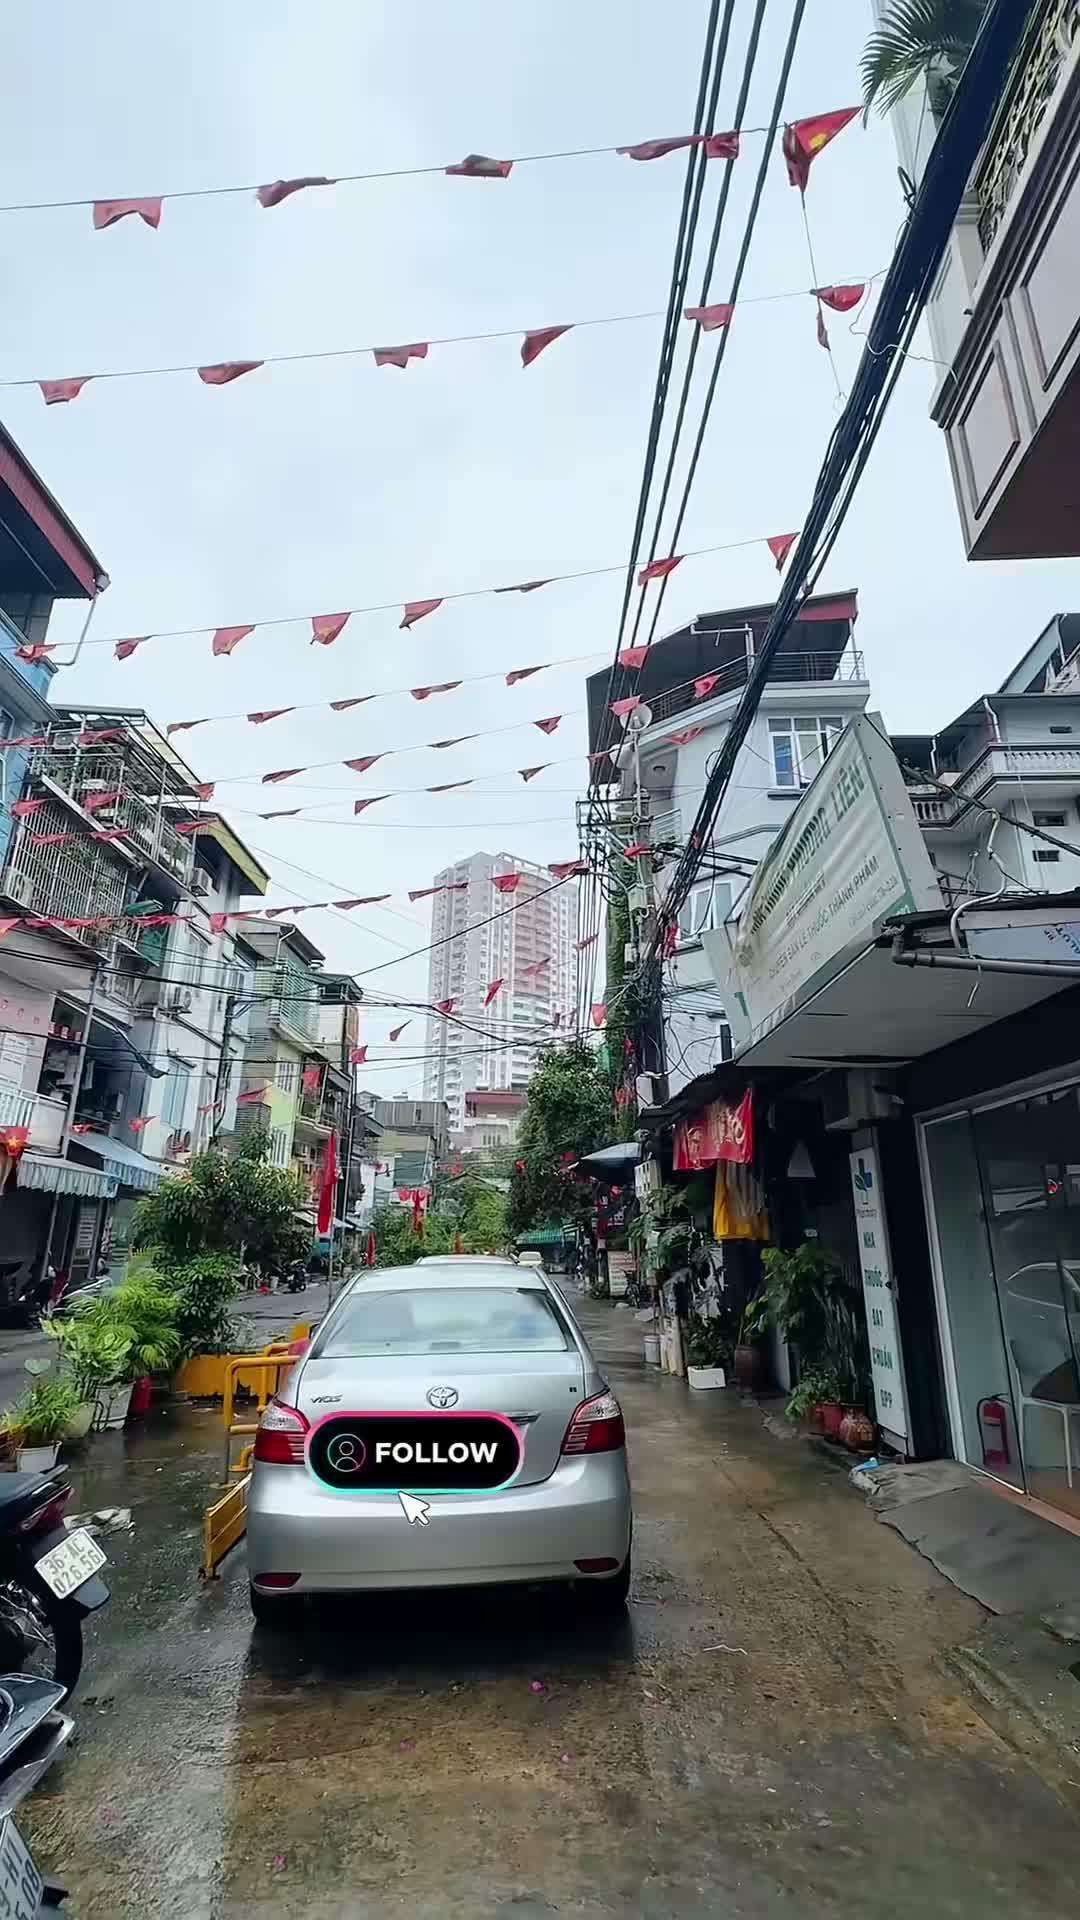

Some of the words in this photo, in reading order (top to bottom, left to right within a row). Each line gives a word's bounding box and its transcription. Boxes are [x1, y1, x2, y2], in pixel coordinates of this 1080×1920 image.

[831, 763, 865, 823] LIÊN
[44, 1537, 85, 1575] 36-AC
[53, 1549, 101, 1594] 026.56
